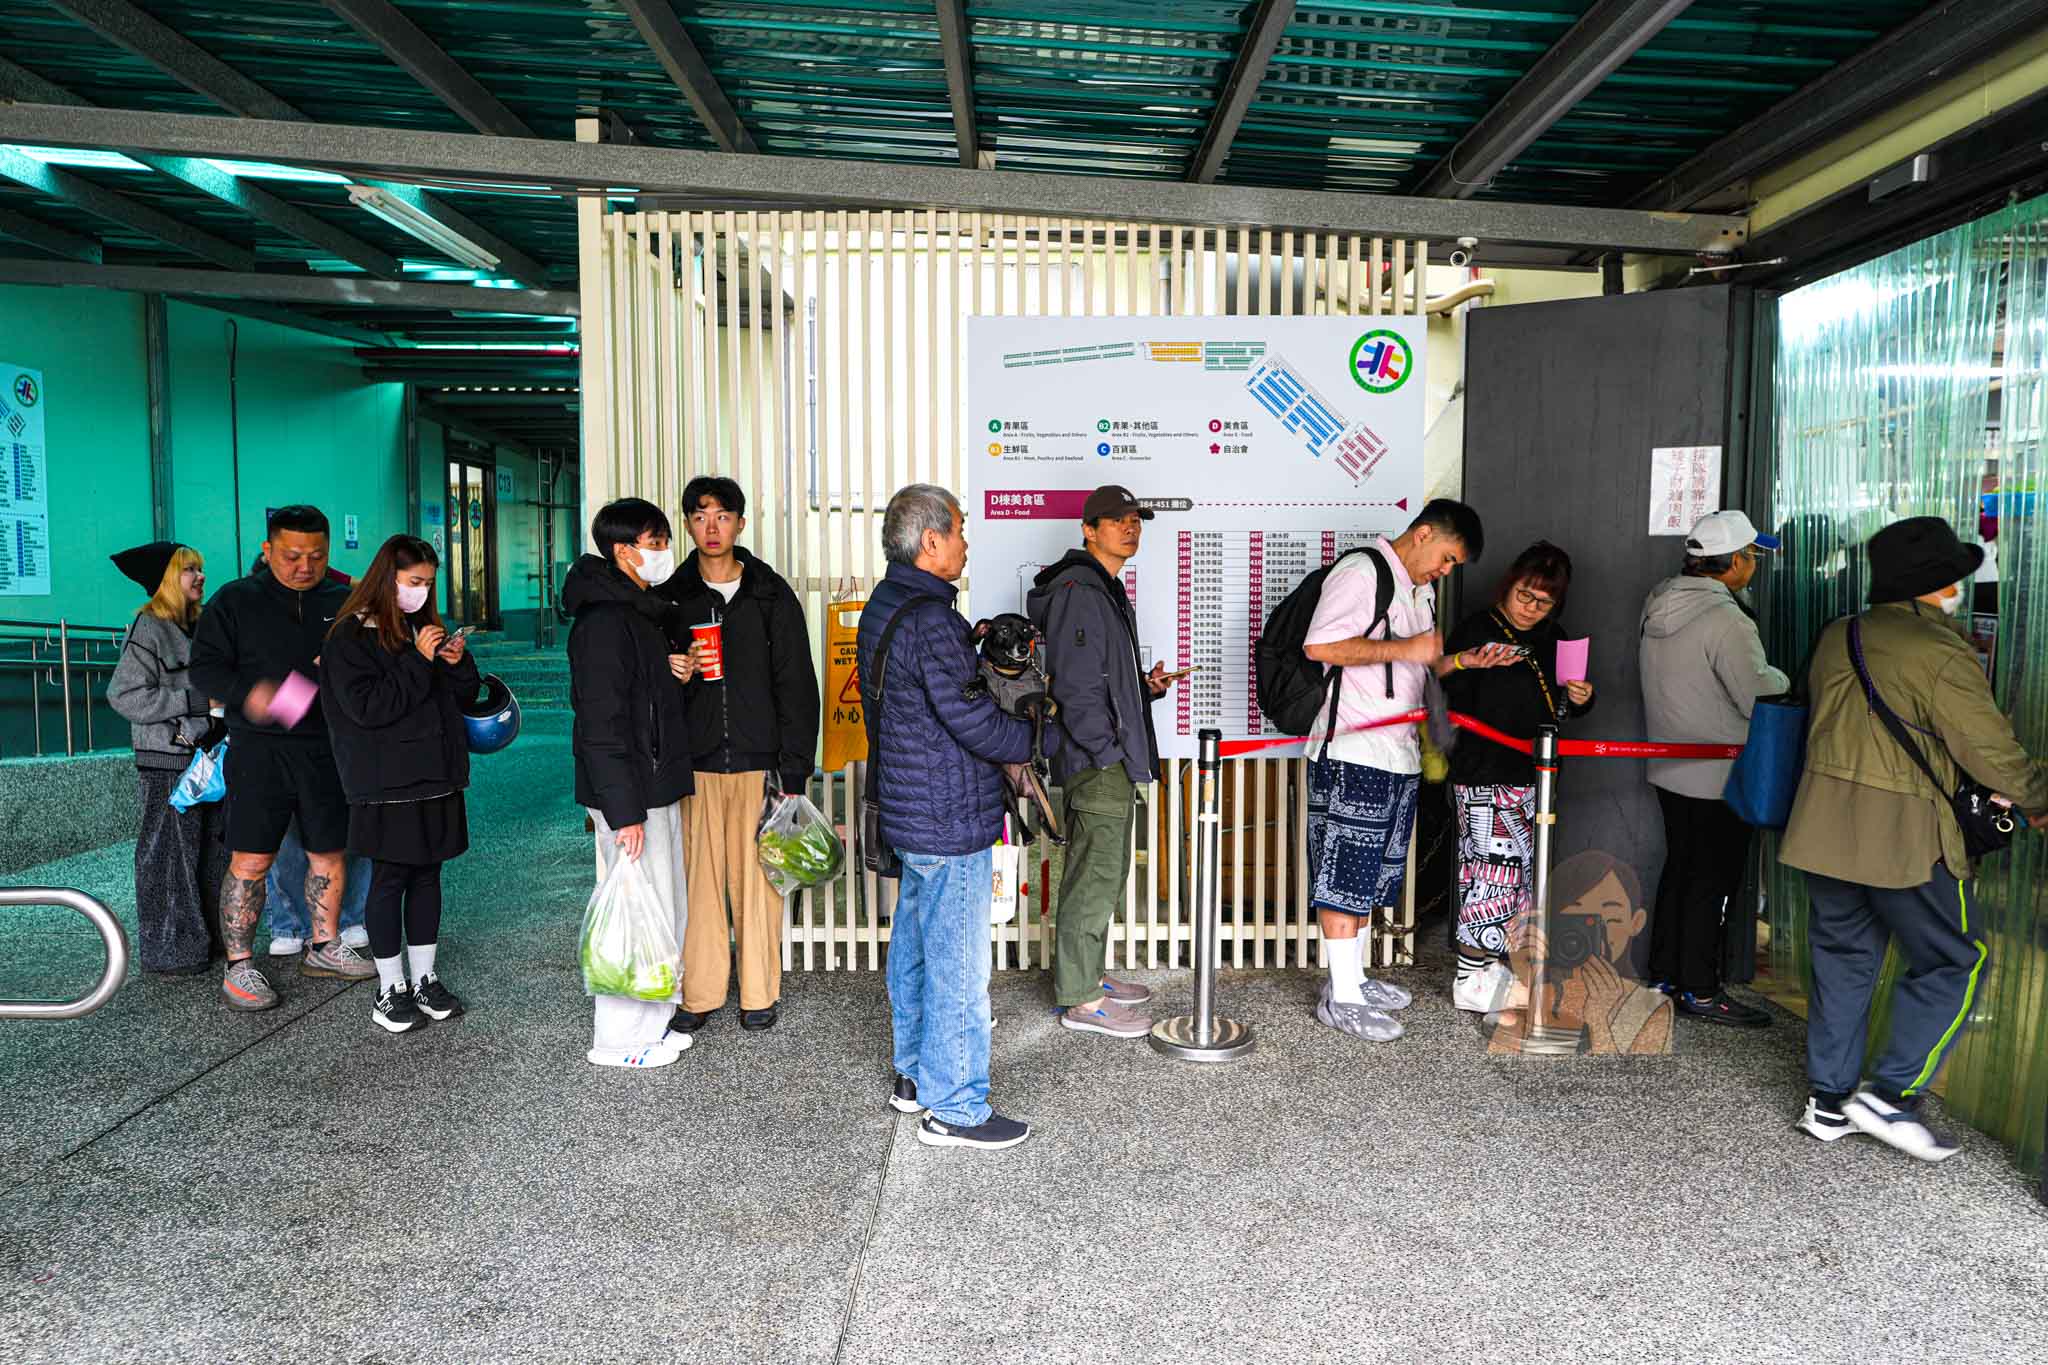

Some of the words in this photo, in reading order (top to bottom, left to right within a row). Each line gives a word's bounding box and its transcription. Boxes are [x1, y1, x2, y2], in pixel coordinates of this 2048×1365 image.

[1004, 422, 1028, 430] 青果區
[1224, 421, 1248, 430] 美食區
[1004, 445, 1028, 454] 生鮮區
[1112, 445, 1136, 454] 百貨區
[1224, 445, 1248, 453] 自治會
[991, 494, 1045, 506] D棟美食區
[840, 648, 856, 656] CAU
[833, 706, 860, 724] 小心
